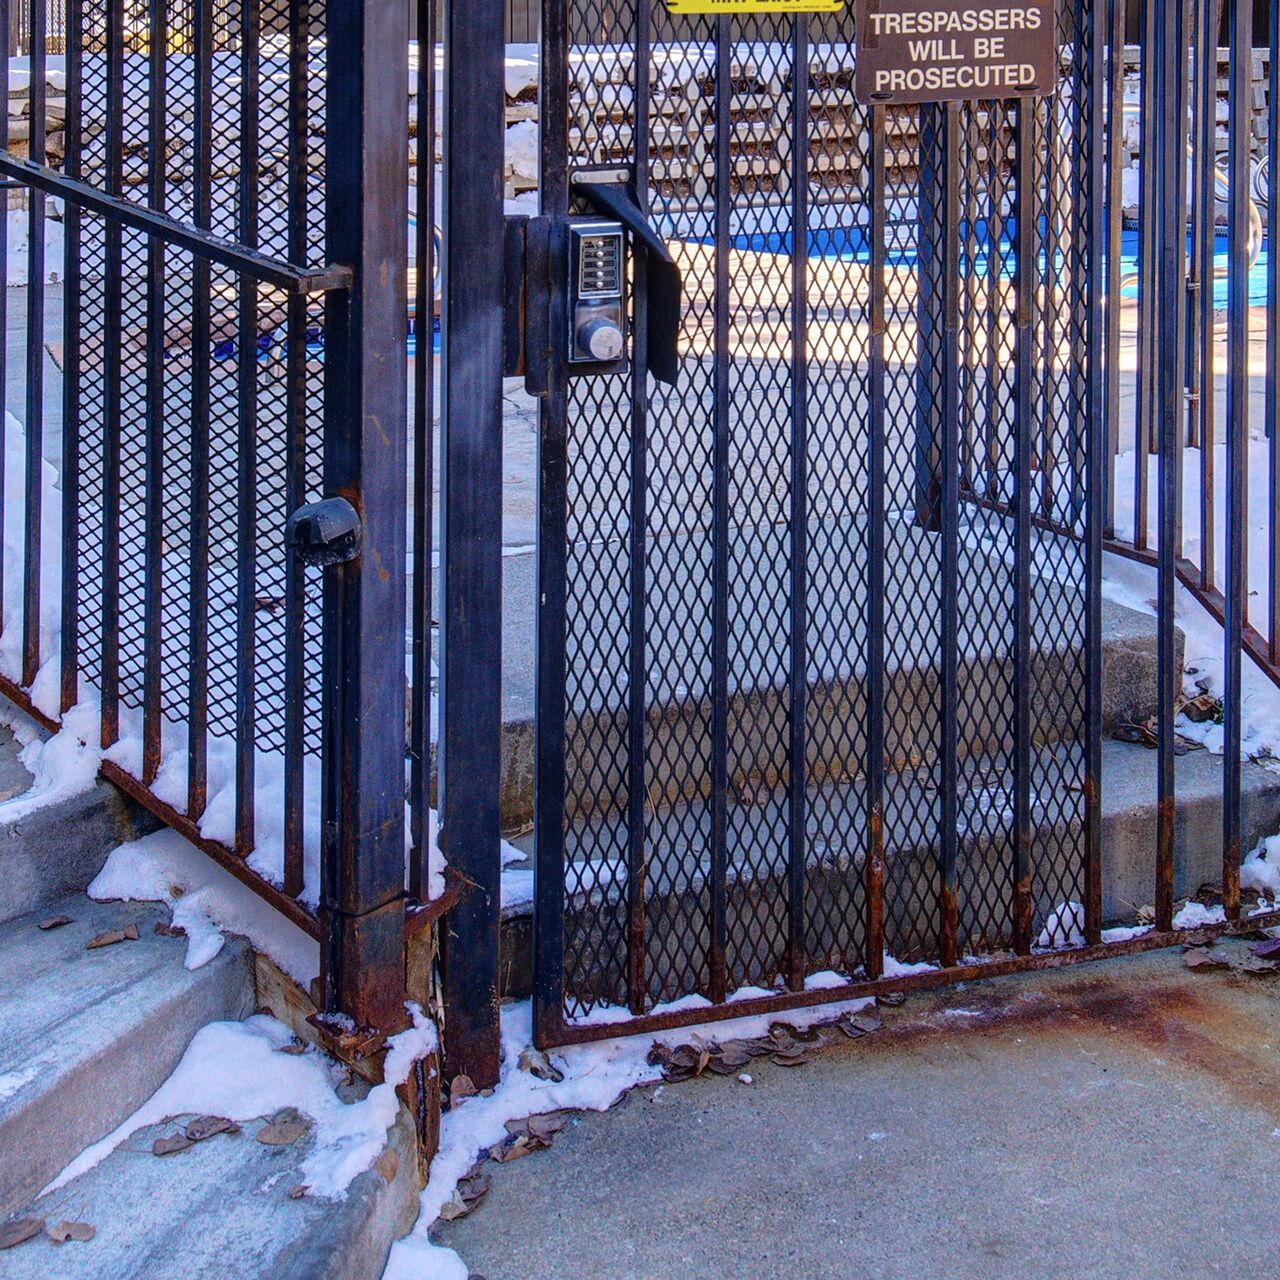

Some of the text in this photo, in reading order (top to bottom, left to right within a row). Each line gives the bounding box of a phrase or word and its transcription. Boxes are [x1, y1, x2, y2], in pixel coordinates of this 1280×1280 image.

[869, 7, 1042, 36] TRESPASSERS
[908, 37, 1005, 62] WILL BE
[875, 64, 1036, 92] PROSECUTED
